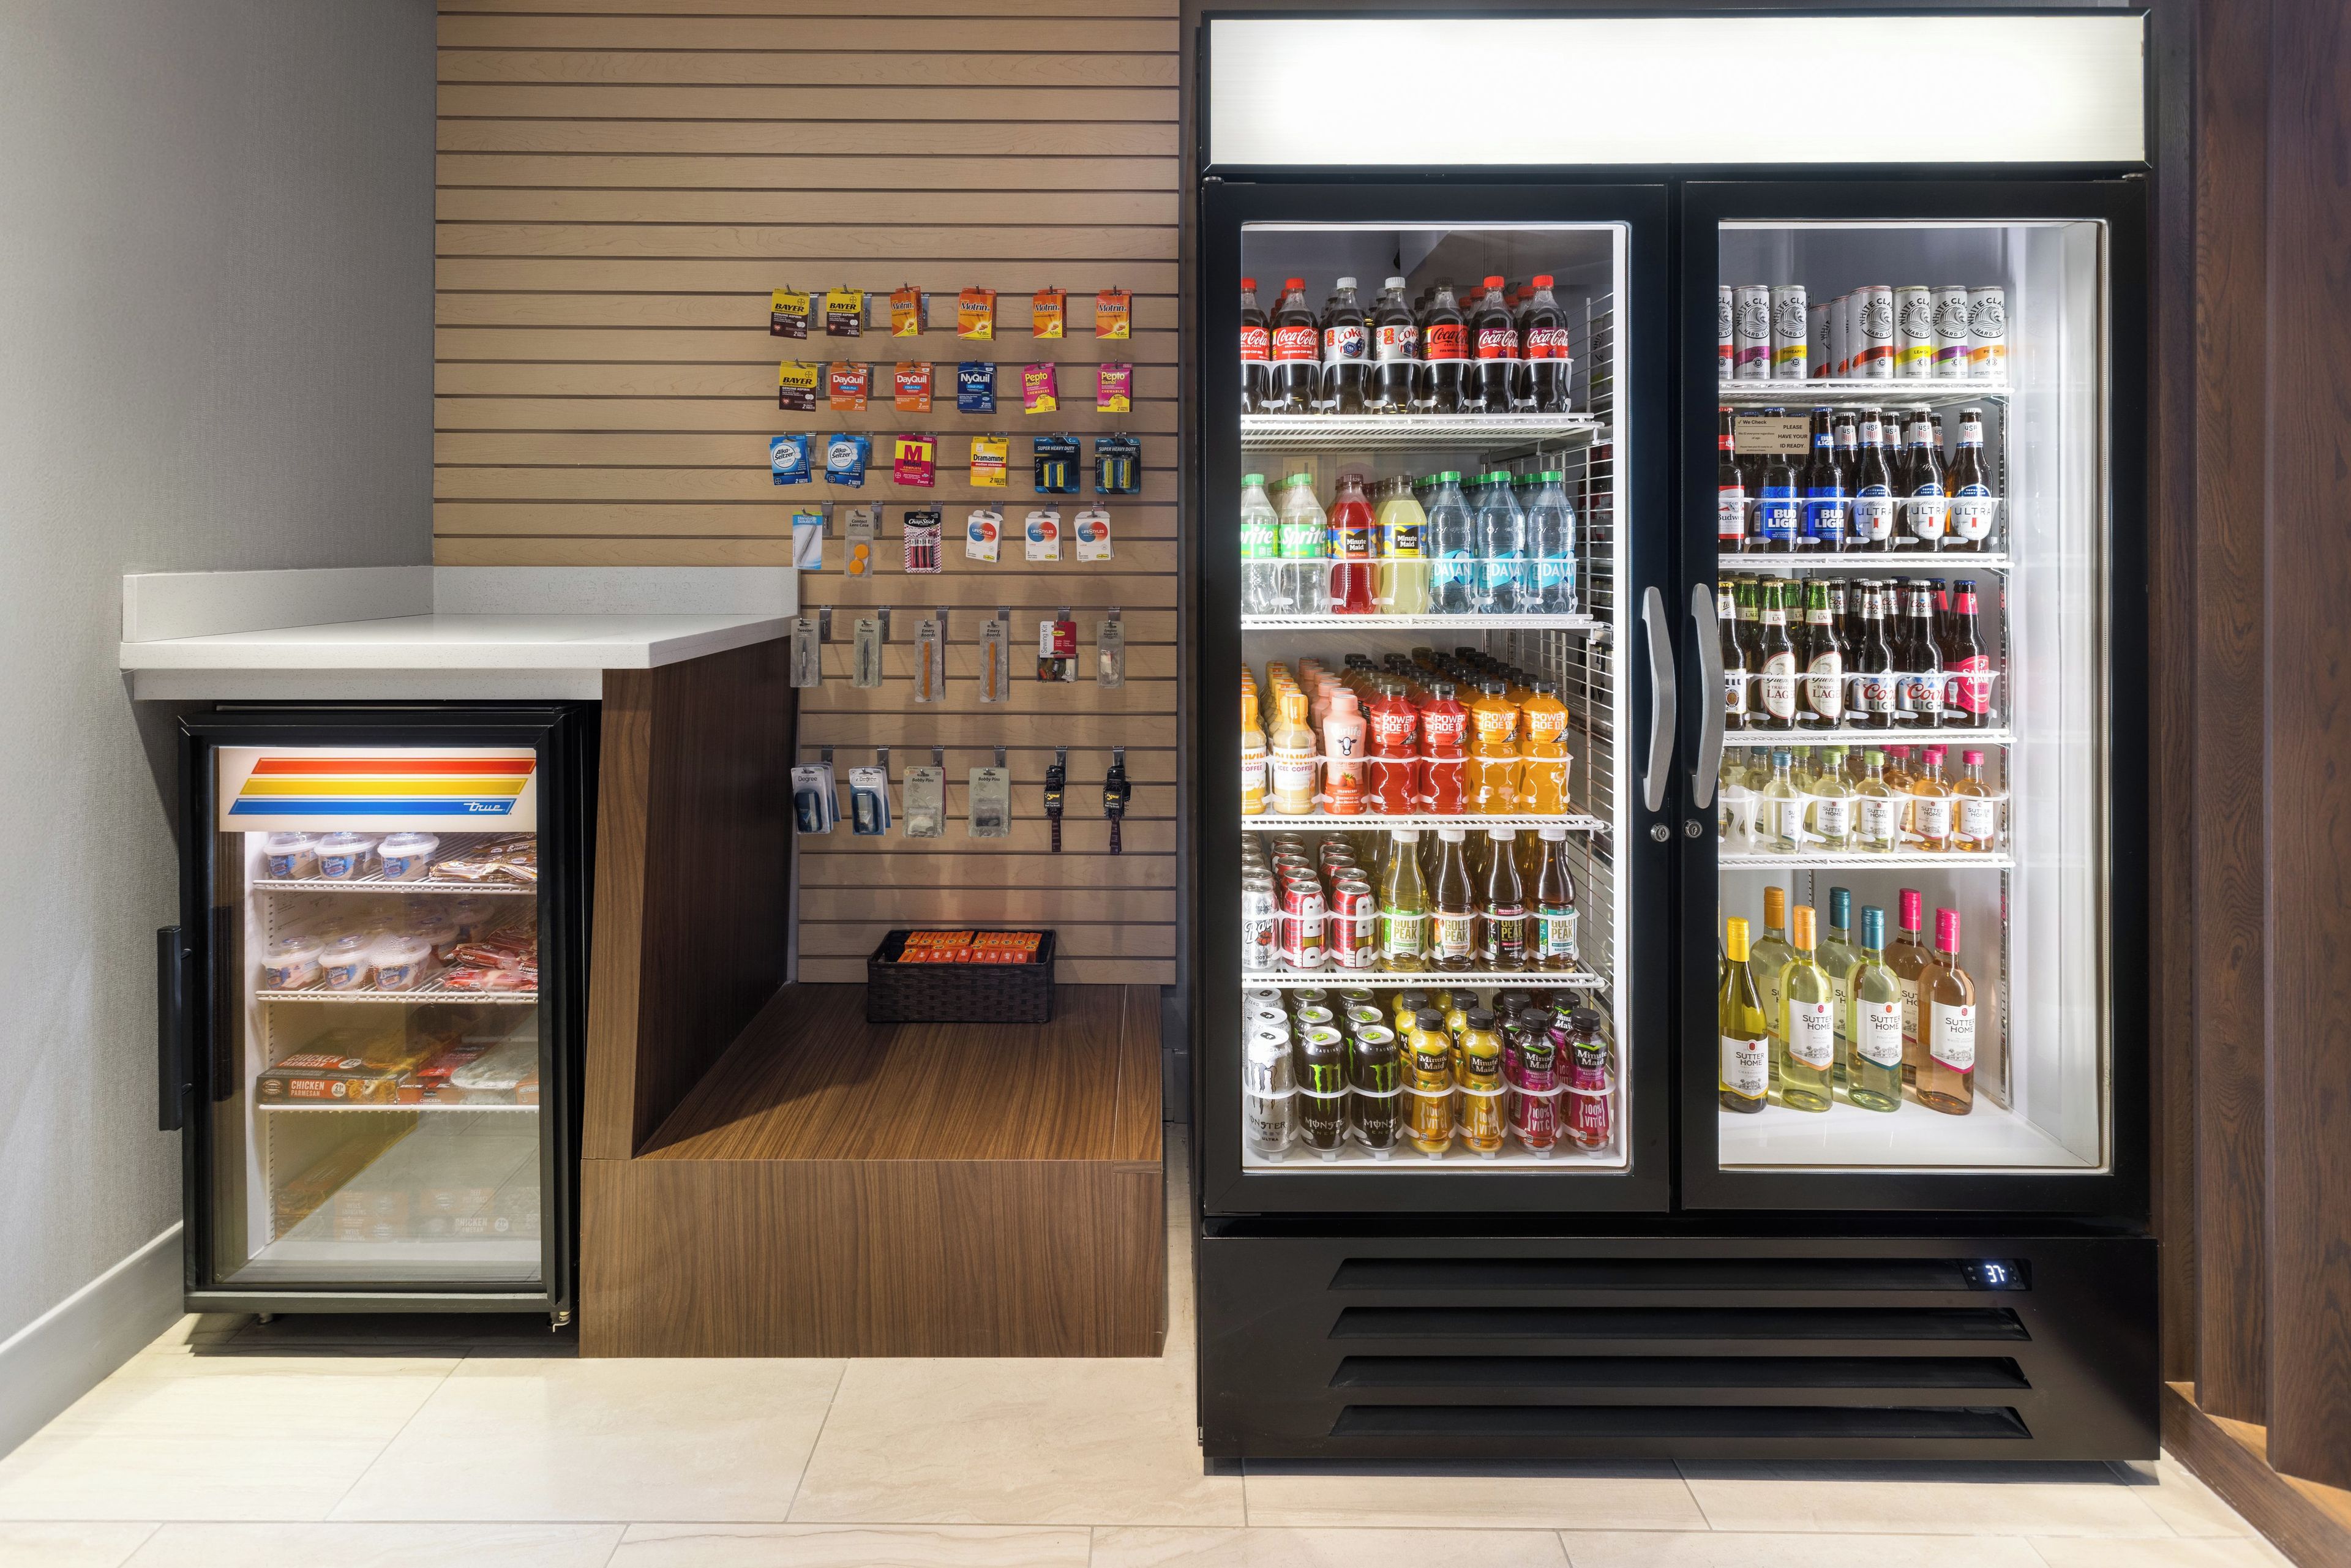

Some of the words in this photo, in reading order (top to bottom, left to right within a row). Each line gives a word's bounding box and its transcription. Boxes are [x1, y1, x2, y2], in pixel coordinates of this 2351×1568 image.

[775, 303, 804, 312] BAYER
[892, 301, 912, 310] Motrin
[961, 301, 988, 312] Motrin
[1034, 303, 1057, 312] Motrin
[1098, 303, 1125, 312] Motrin
[1736, 301, 1750, 327] WHITE
[1773, 300, 1788, 326] WHITE
[1859, 301, 1875, 326] WHITE
[1899, 300, 1916, 326] WHITE
[1932, 300, 1949, 326] WHITE
[1967, 301, 1985, 326] WHITE
[1277, 329, 1317, 346] Coca-Cola
[1479, 329, 1518, 349] Coca-Cola
[1528, 329, 1569, 348] Coca-Cola
[833, 375, 863, 384] DayQuil
[897, 375, 927, 384] DayQuil
[961, 373, 989, 383] NyQuil
[1025, 373, 1048, 383] Pepto
[1101, 372, 1125, 382] Pepto
[904, 445, 923, 460] M
[1774, 509, 1796, 518] BUD
[1821, 509, 1843, 519] BUD
[1768, 519, 1797, 528] LIGH
[1815, 519, 1843, 528] LIGH
[1281, 527, 1326, 549] Sprite
[1434, 563, 1473, 581] DASANI
[1384, 715, 1414, 724] POWER
[1435, 714, 1466, 723] POWER
[1485, 713, 1515, 721] POWER
[1533, 713, 1565, 721] POWER
[1382, 724, 1402, 732] ADE
[1394, 920, 1418, 928] GOLD
[1445, 920, 1468, 930] GOLD
[1393, 928, 1417, 939] PEAK
[1445, 931, 1468, 941] PEAK
[1501, 926, 1523, 938] PEAK
[1551, 928, 1572, 939] PEAK
[1802, 1015, 1832, 1023] SUTTER
[1870, 1015, 1900, 1024] SUTTER
[1945, 1017, 1974, 1026] SUTTER
[287, 1054, 343, 1063] CHICKEN
[1419, 1054, 1448, 1063] Minute
[1526, 1052, 1555, 1062] Minute
[1577, 1049, 1607, 1060] Minute
[1425, 1062, 1445, 1070] Maid
[1471, 1057, 1498, 1067] Minute
[1530, 1059, 1552, 1068] Maid
[1581, 1057, 1605, 1066] Maid
[1475, 1065, 1494, 1073] Maid
[291, 1080, 324, 1090] CHICKEN
[1532, 1106, 1550, 1118] 100%
[1584, 1104, 1602, 1116] 100%
[1532, 1120, 1543, 1131] VIT
[1545, 1119, 1551, 1130] C
[1584, 1117, 1597, 1128] VIT
[1599, 1116, 1603, 1127] C
